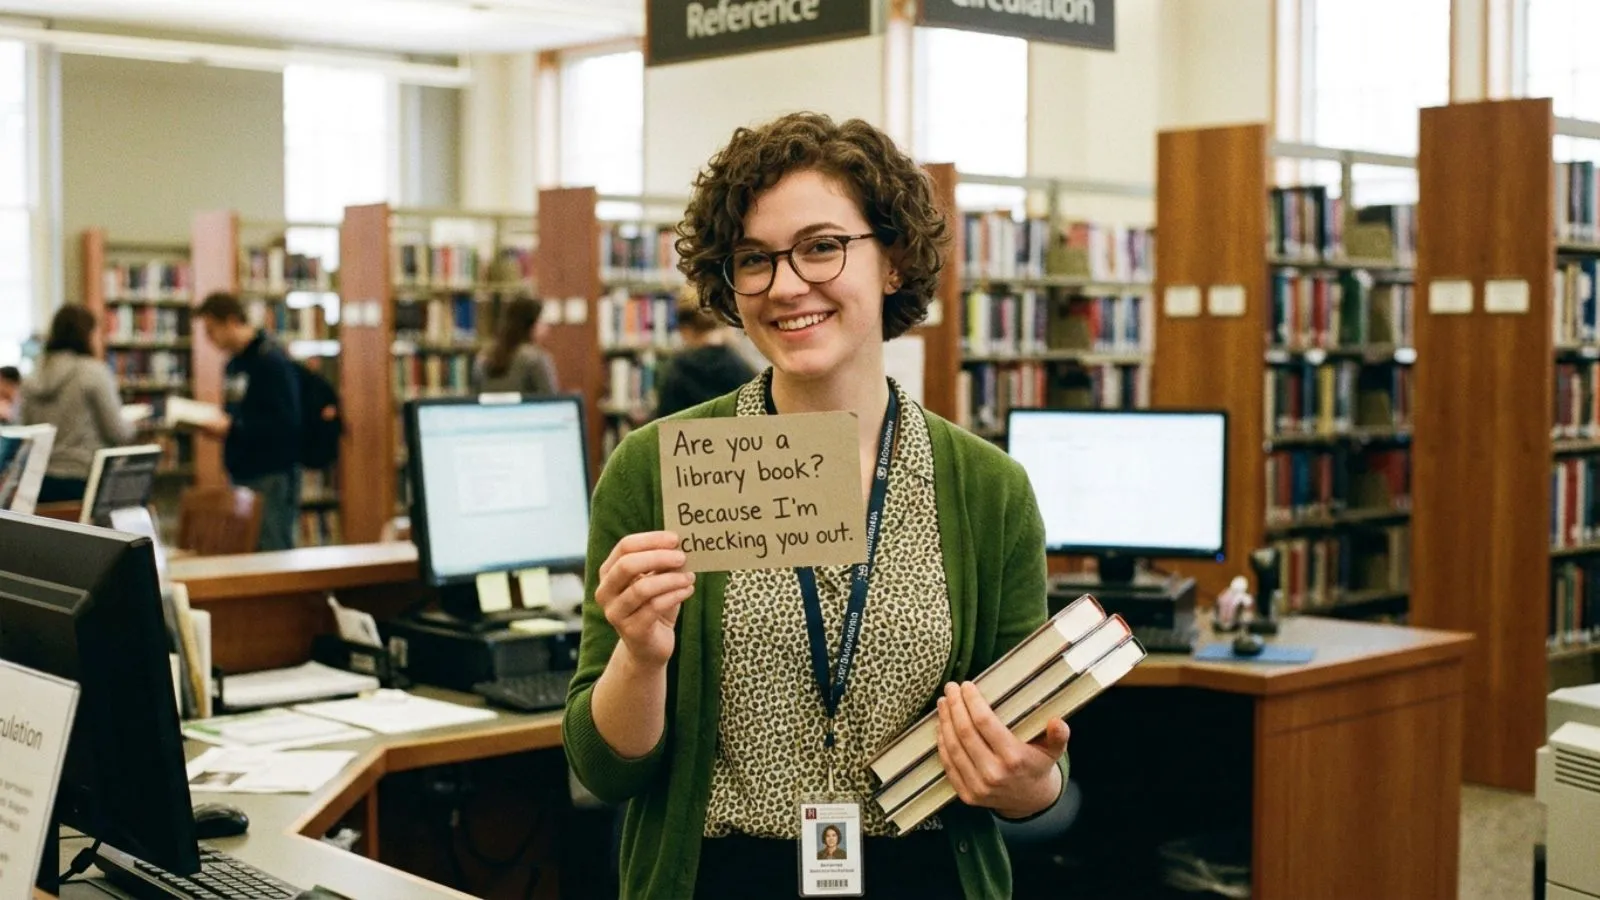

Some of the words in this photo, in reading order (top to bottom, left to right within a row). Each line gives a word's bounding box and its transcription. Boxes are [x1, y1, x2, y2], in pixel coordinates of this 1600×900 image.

[686, 0, 820, 39] Reference
[673, 430, 715, 457] Are
[726, 435, 763, 462] you
[776, 434, 790, 449] a
[676, 465, 745, 494] library
[757, 454, 824, 481] book?
[678, 502, 763, 526] Because
[773, 497, 818, 519] I'm
[681, 531, 768, 558] checking
[776, 531, 809, 555] you
[816, 522, 854, 544] out.
